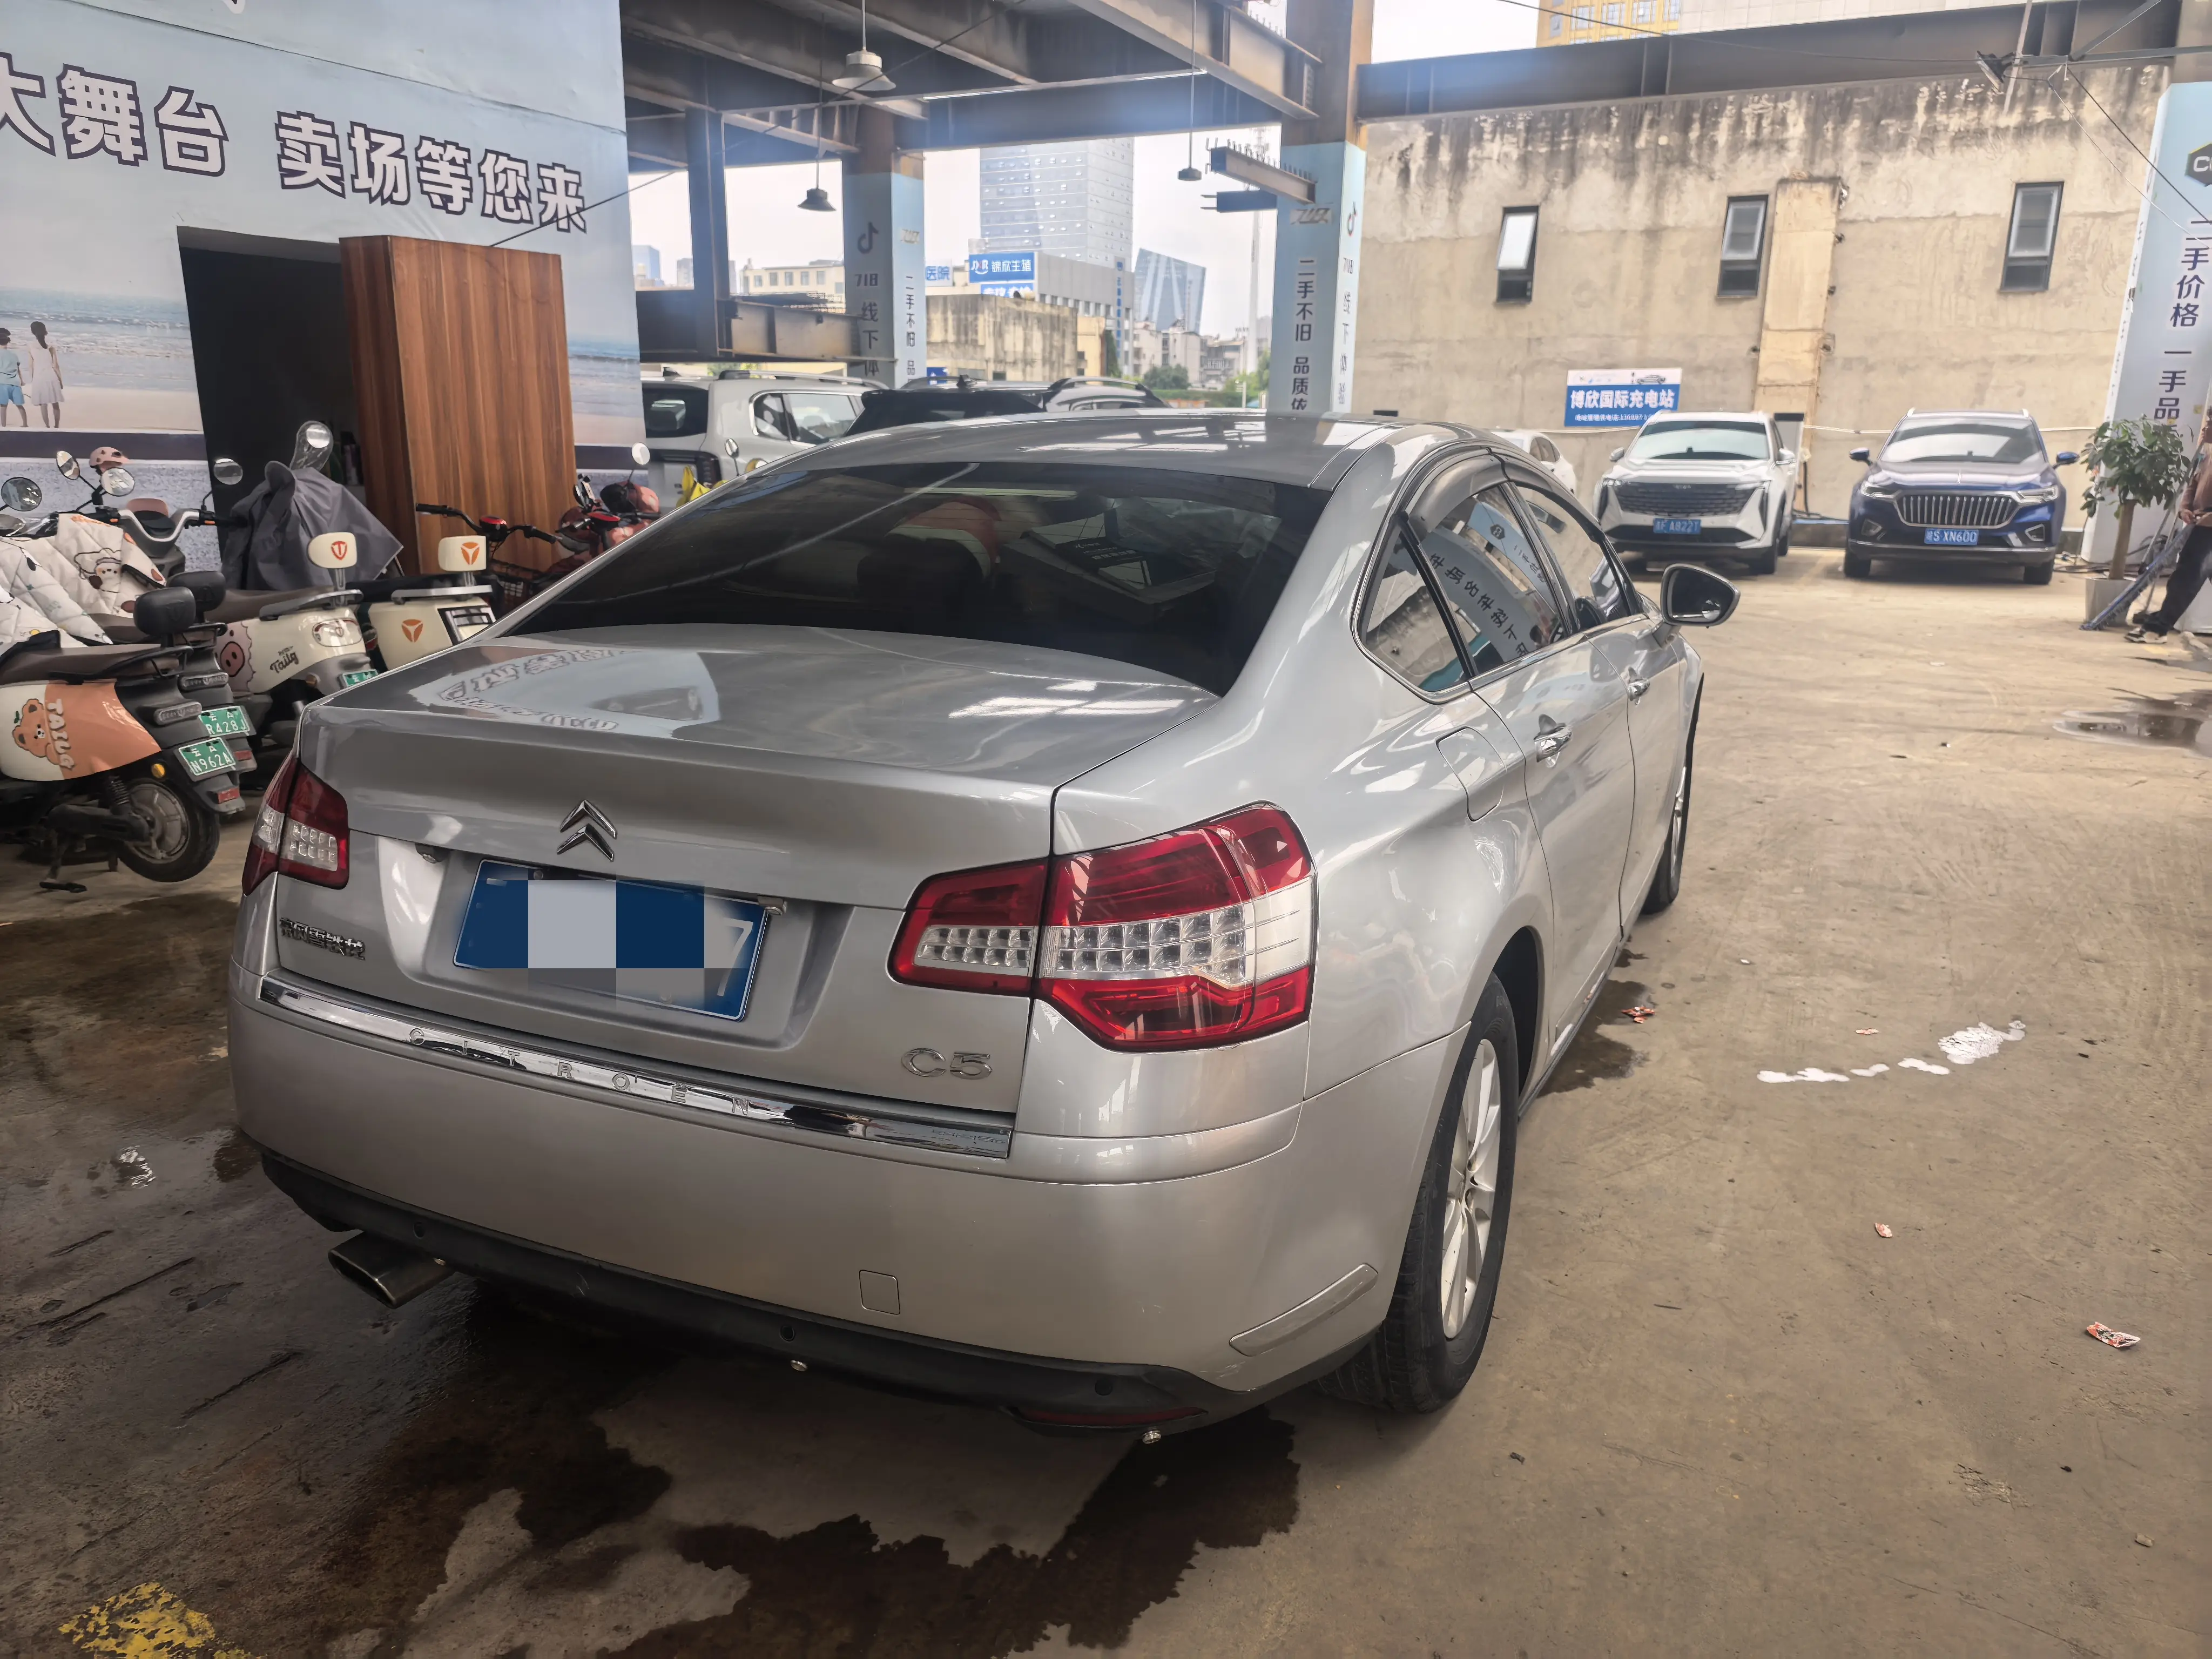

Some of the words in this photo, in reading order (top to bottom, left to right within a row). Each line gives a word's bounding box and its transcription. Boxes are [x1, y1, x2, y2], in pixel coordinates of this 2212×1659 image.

[275, 110, 587, 234] 卖场等您来
[925, 266, 950, 281] 医院
[2170, 220, 2212, 328] 二手价格
[906, 276, 916, 347] 二手不旧
[1296, 260, 1316, 342] 二手不旧
[1570, 388, 1675, 409] 博欣国际充电站
[2154, 350, 2193, 434] 一手品
[270, 651, 299, 674] Tailg
[190, 752, 233, 773] N962A
[901, 1048, 993, 1081] C5
